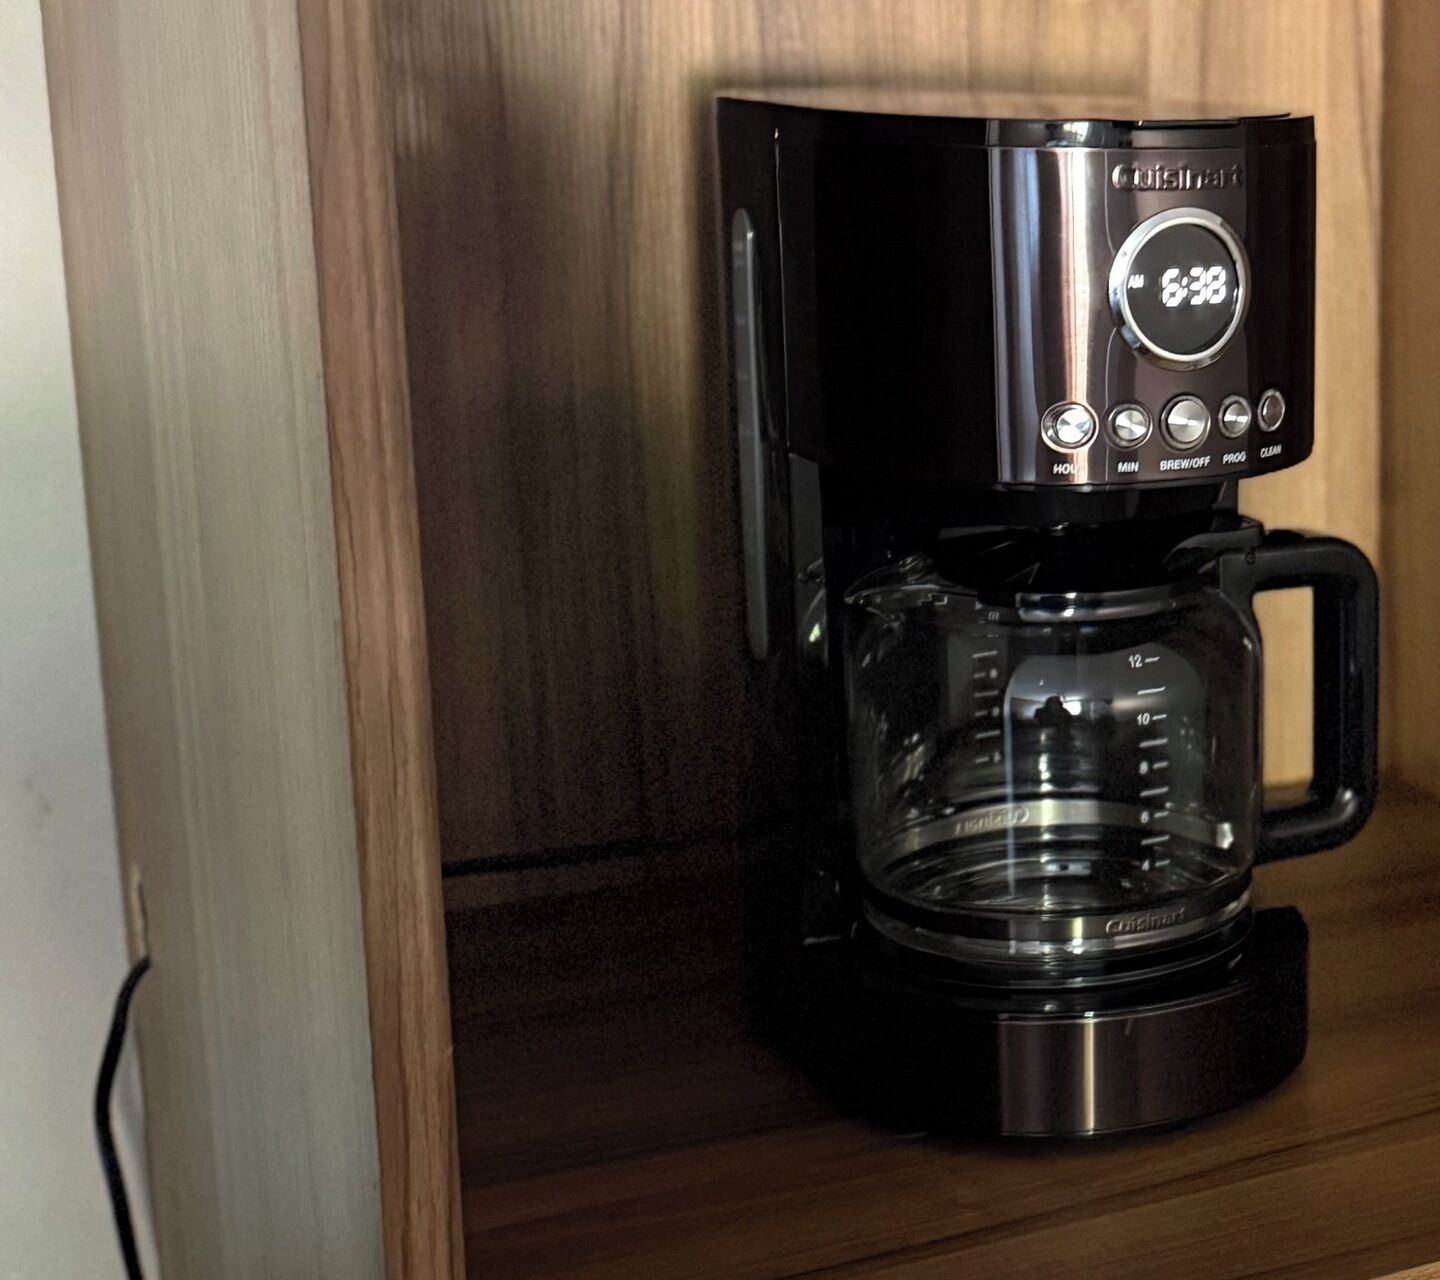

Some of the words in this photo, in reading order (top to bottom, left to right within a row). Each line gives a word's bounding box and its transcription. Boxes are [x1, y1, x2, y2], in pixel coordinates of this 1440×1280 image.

[1161, 266, 1227, 308] 6:38
[1222, 451, 1247, 464] PROG
[1260, 443, 1282, 458] CLEAN
[1117, 461, 1139, 473] MIN
[1159, 455, 1211, 471] BREW/OFF
[1128, 654, 1143, 669] 12
[1137, 713, 1150, 725] 10
